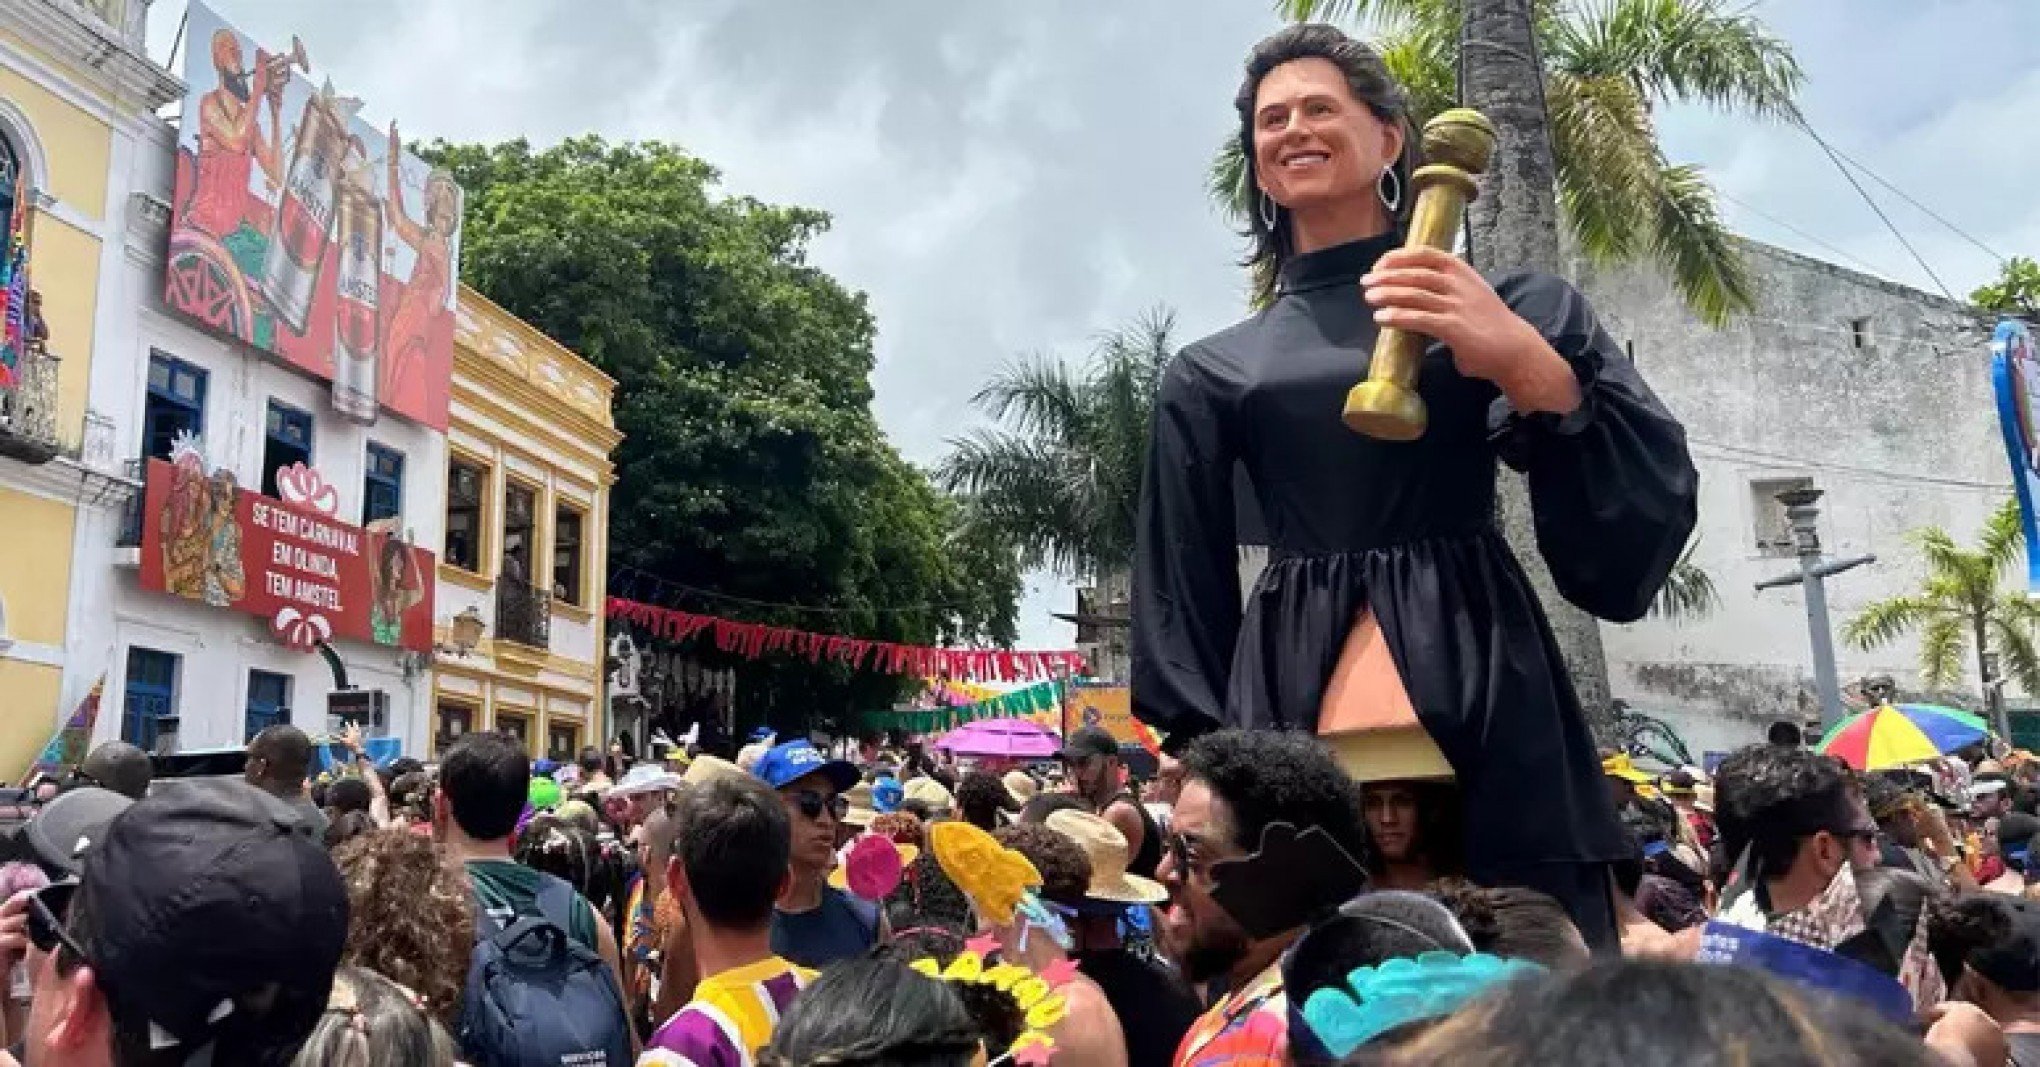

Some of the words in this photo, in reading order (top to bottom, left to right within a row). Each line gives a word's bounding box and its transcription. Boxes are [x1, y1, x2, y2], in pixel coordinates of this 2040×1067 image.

[252, 502, 270, 528] SE
[271, 507, 299, 535] TEM
[300, 518, 359, 557] CARNAVAL
[273, 540, 291, 565] EM
[294, 547, 341, 583] OLINDA,
[266, 570, 294, 598] TEM
